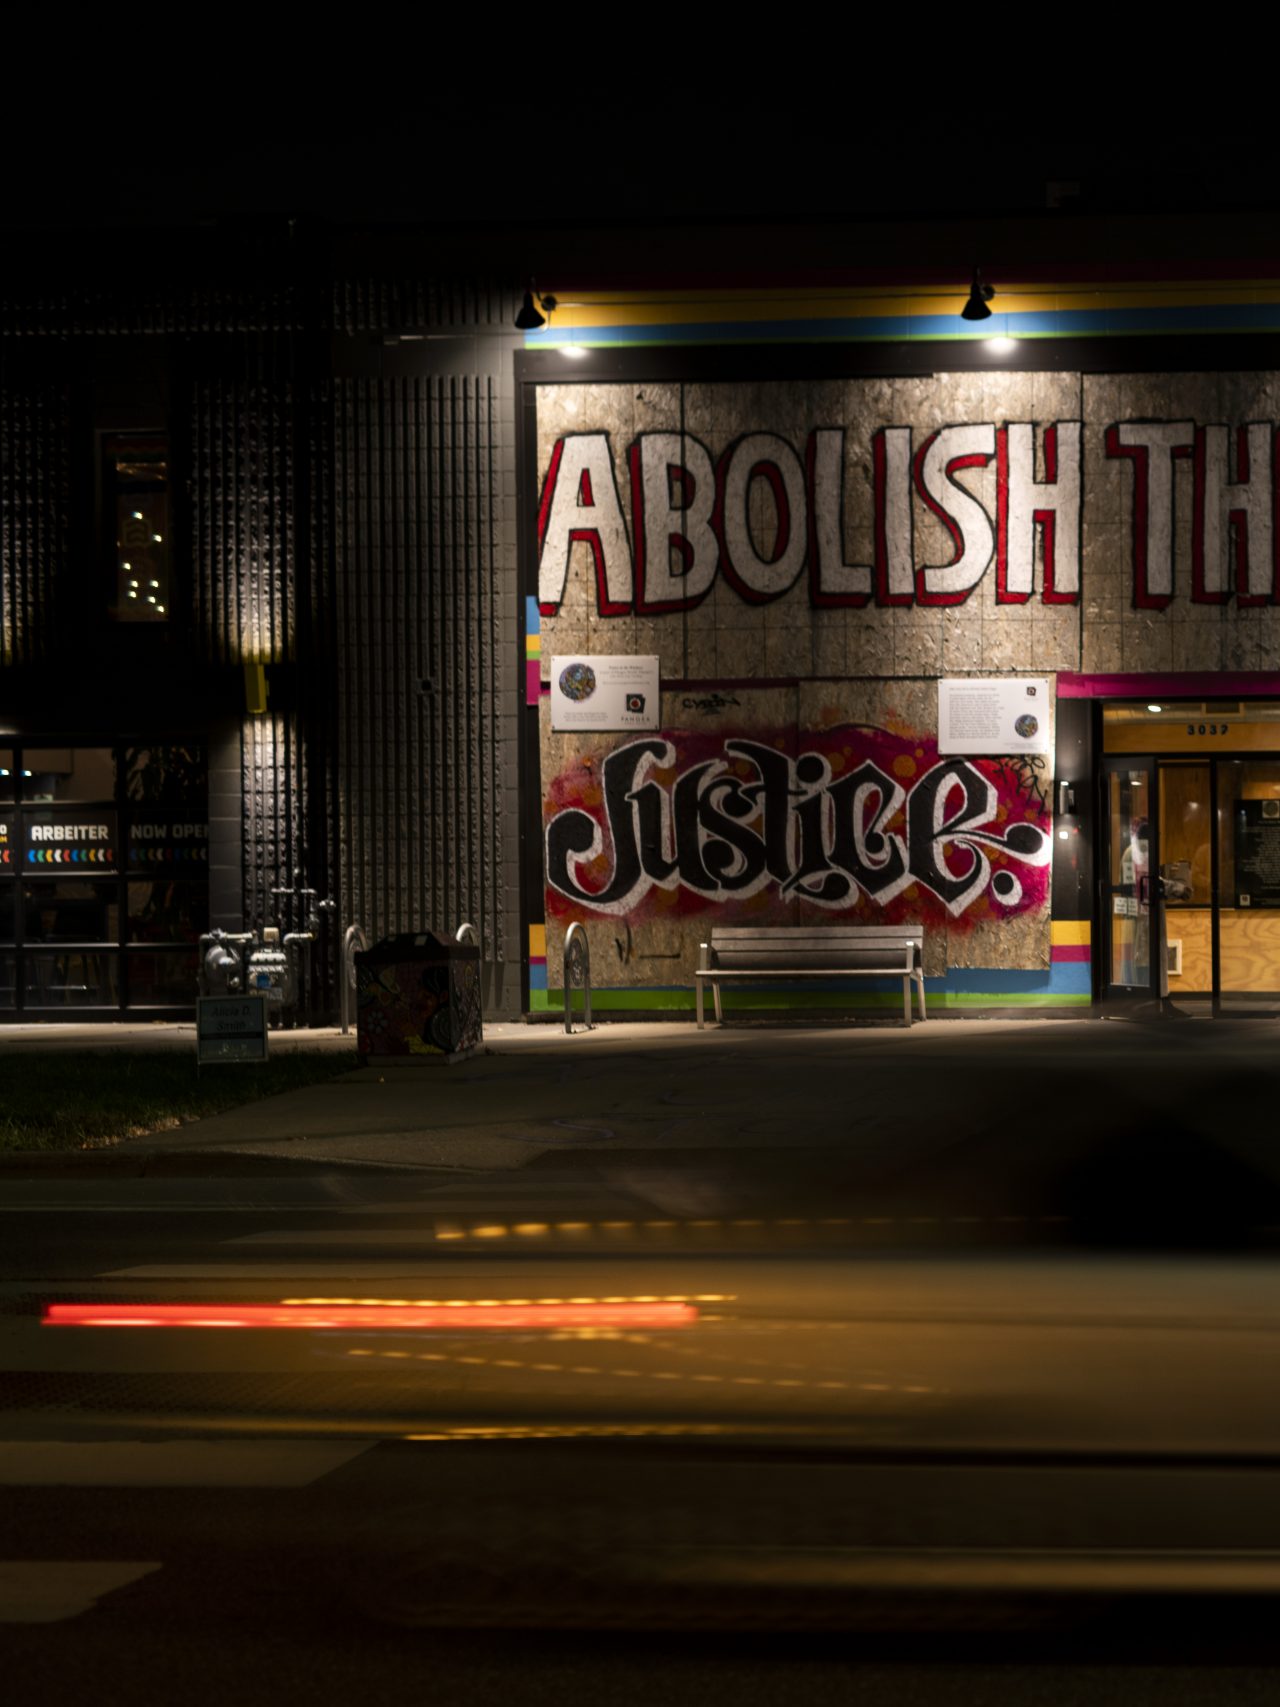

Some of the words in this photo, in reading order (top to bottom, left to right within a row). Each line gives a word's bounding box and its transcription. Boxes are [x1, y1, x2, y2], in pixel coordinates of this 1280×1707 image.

[537, 420, 1086, 617] ABOLISH
[1188, 724, 1228, 735] 3037
[31, 825, 109, 841] ARBEITER
[131, 824, 167, 840] NOW
